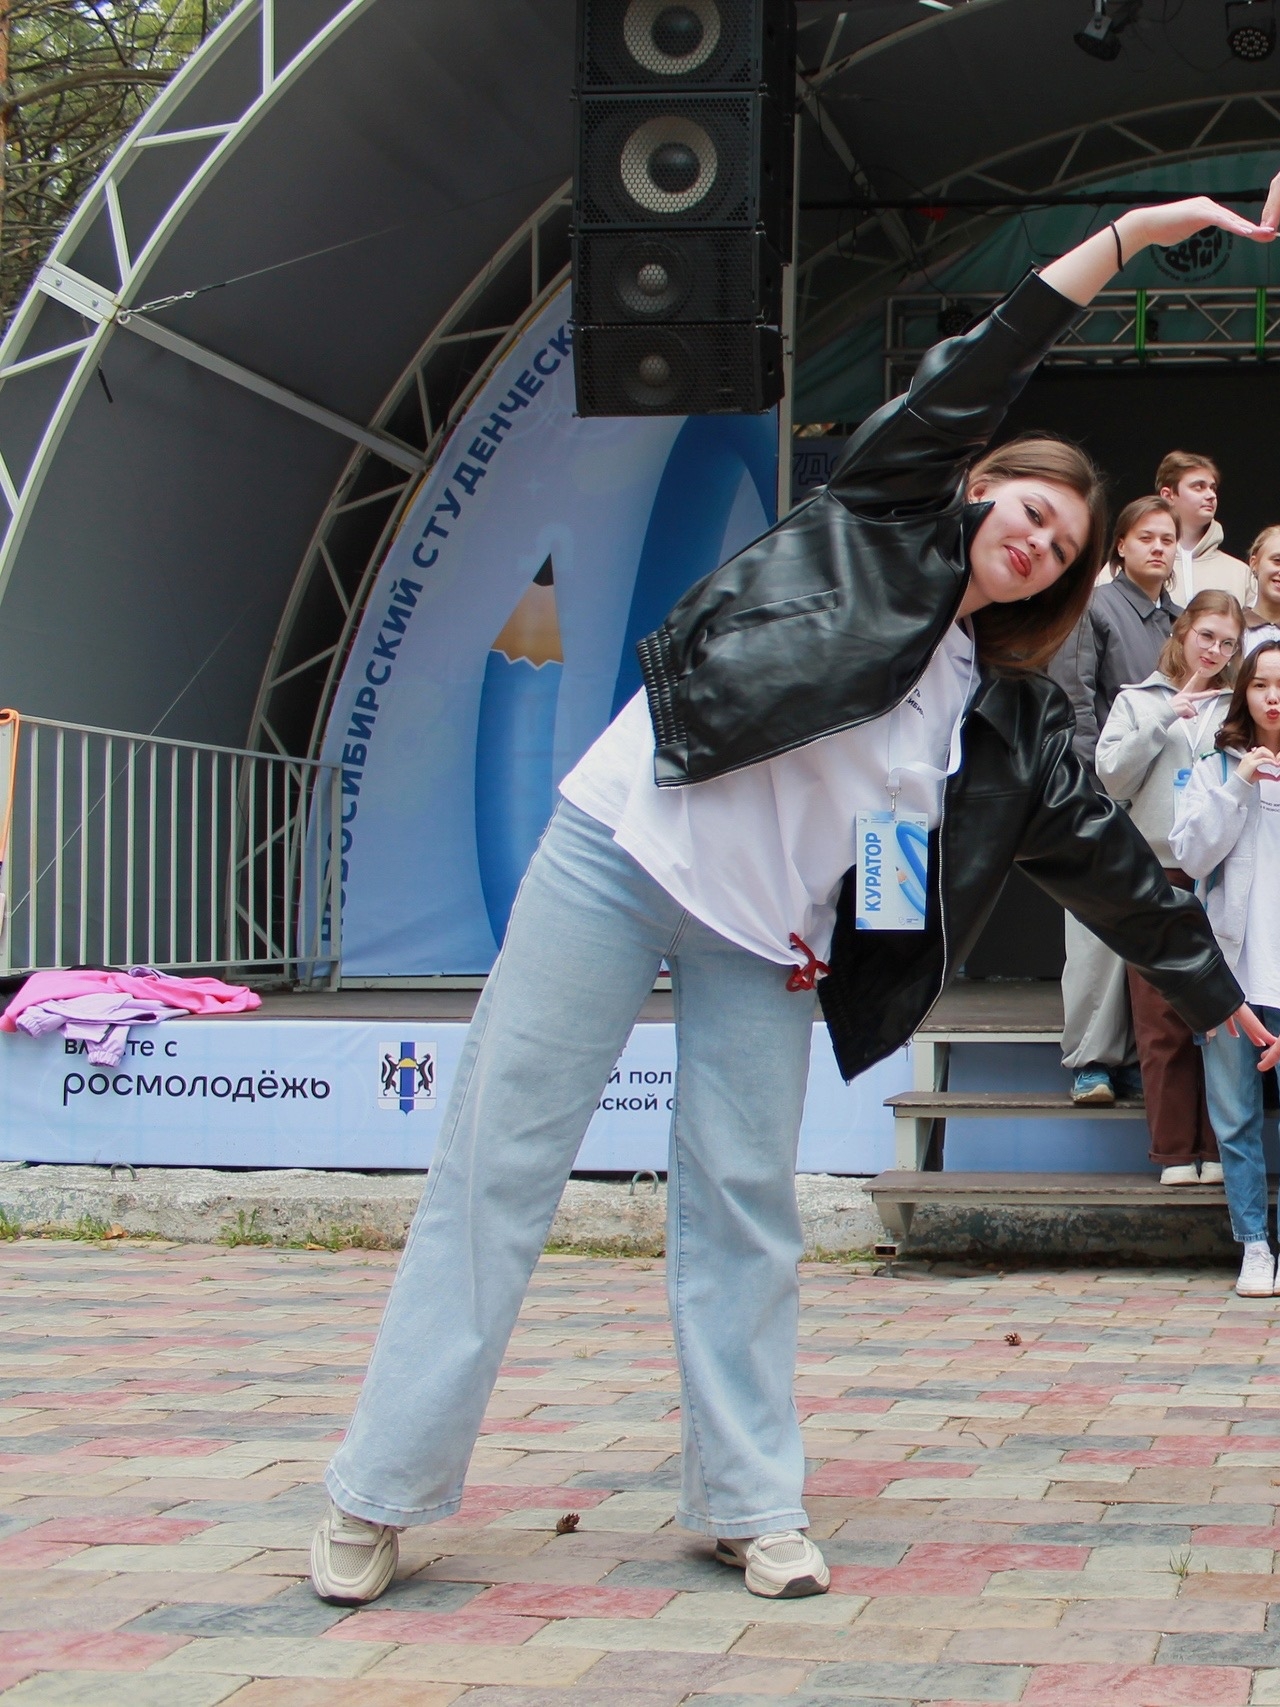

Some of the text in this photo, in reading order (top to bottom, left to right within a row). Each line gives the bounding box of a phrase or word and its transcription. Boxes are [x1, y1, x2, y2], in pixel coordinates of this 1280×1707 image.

[865, 832, 882, 911] КУРАТОР
[164, 1041, 178, 1057] с
[63, 1070, 331, 1106] росмолодёжь
